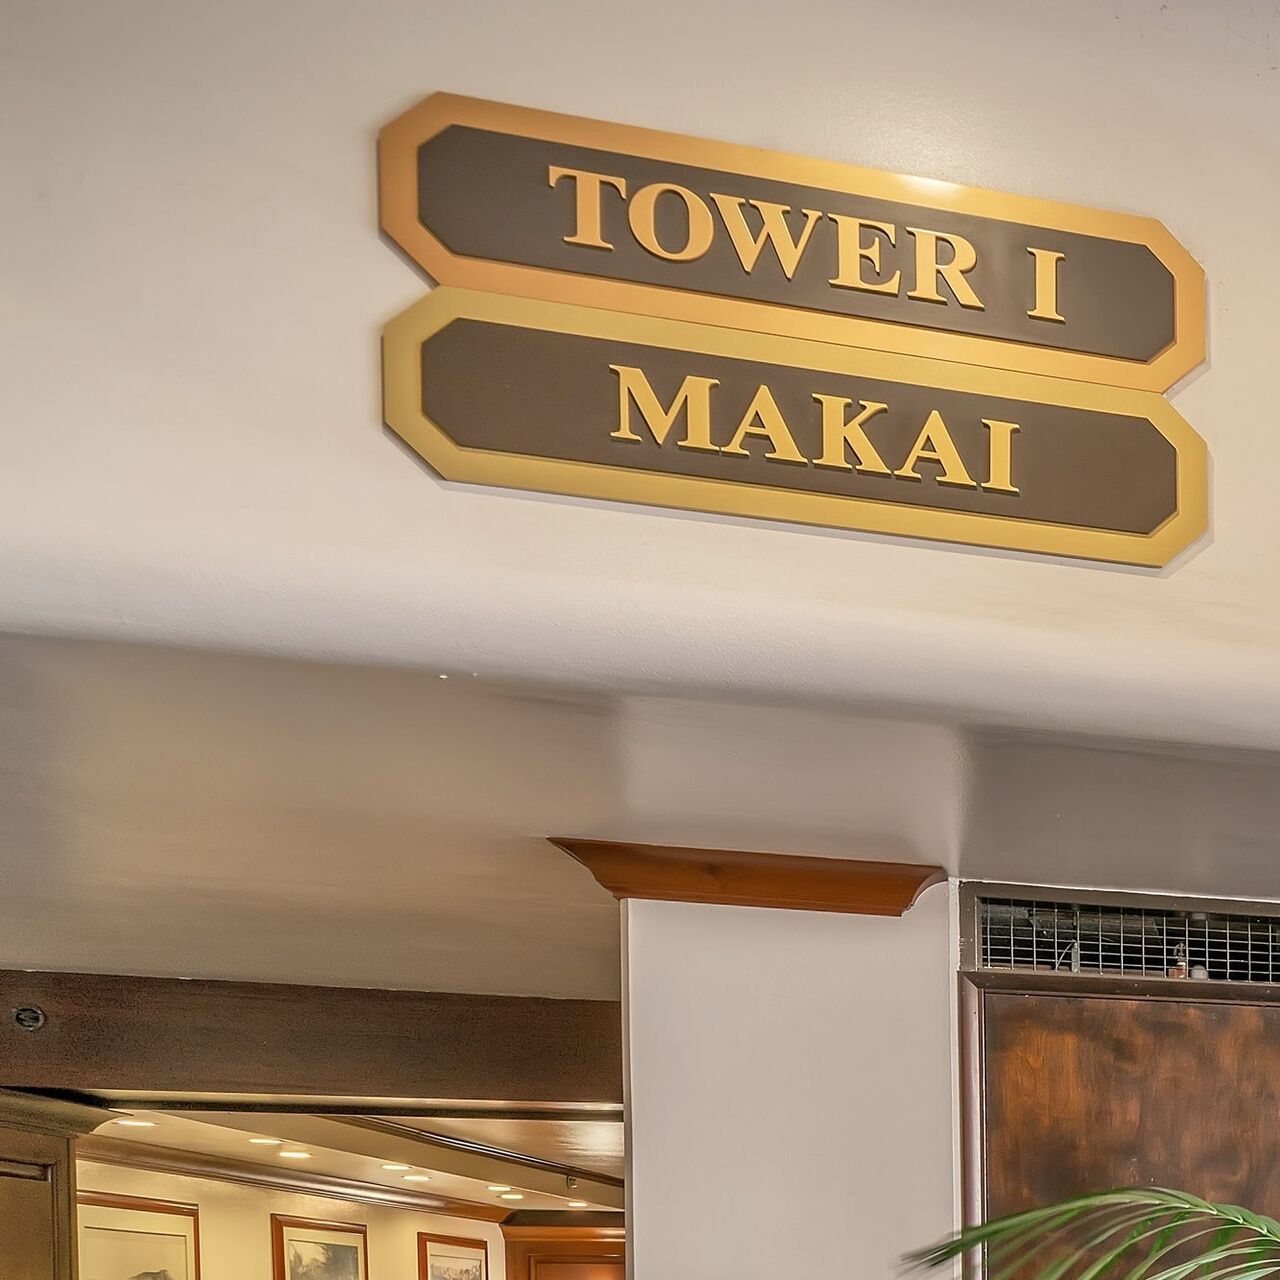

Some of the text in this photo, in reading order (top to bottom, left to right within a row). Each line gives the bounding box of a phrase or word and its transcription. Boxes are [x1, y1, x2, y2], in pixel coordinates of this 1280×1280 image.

[548, 165, 1067, 325] TOWER I
[608, 364, 1021, 494] MAKAI
